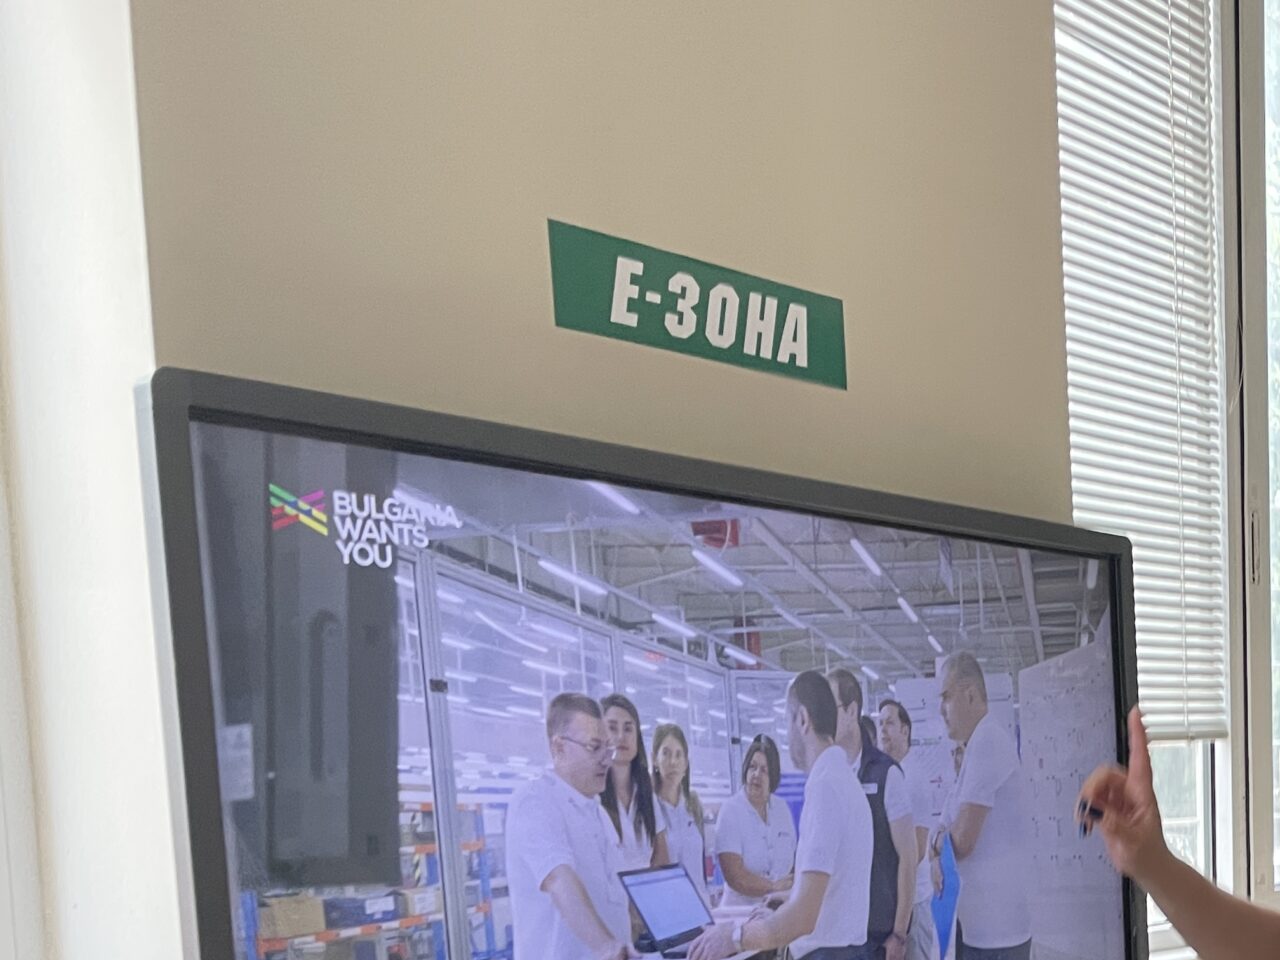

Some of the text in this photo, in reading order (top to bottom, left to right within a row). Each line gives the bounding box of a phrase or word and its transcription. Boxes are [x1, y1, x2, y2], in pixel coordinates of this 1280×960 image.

[610, 255, 808, 368] Е-ЗОНА
[332, 489, 463, 529] BULGARIA
[333, 515, 430, 549] WANTS
[335, 540, 393, 569] YOU
